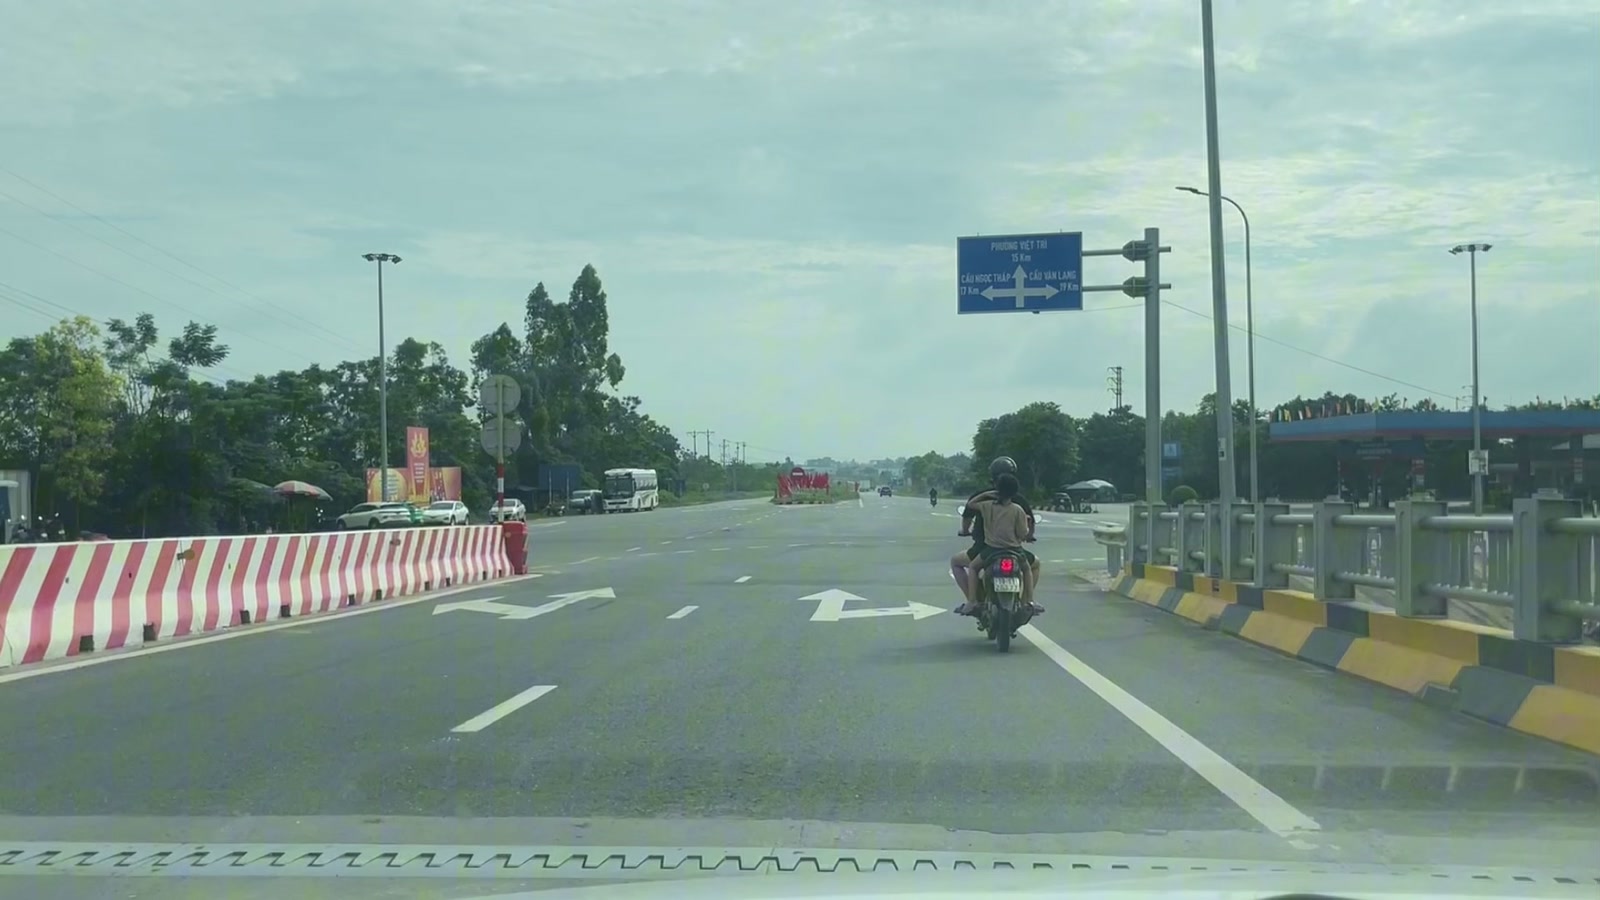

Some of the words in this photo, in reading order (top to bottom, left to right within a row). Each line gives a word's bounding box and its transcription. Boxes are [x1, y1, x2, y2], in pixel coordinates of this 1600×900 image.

[1011, 253, 1019, 262] 15
[1019, 253, 1031, 262] Km
[1058, 270, 1077, 280] LANG
[960, 286, 967, 296] 17
[968, 286, 980, 296] Km
[1067, 282, 1079, 292] Km
